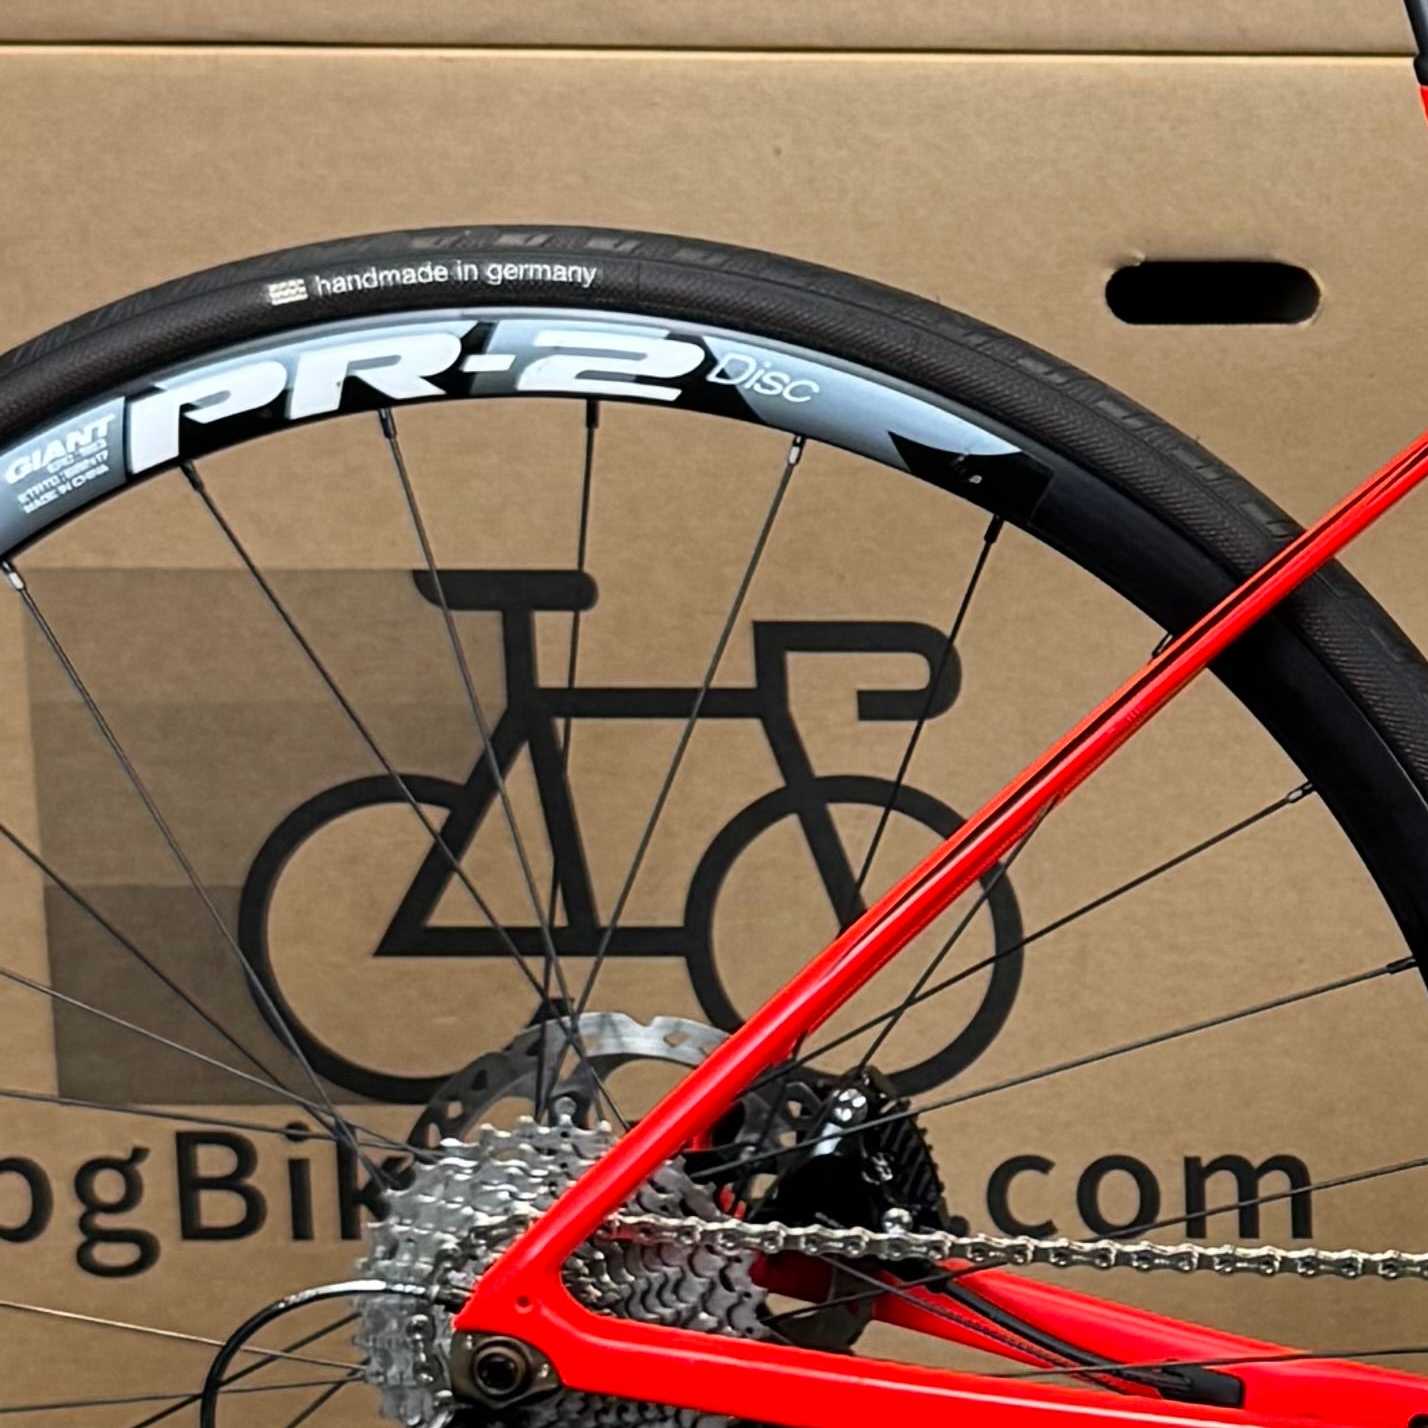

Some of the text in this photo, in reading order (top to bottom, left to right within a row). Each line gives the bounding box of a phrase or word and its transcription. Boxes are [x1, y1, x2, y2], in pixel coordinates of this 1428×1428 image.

[316, 260, 597, 296] handmade in germany
[131, 330, 821, 474] PR-2 Disc
[5, 413, 116, 485] GIANT
